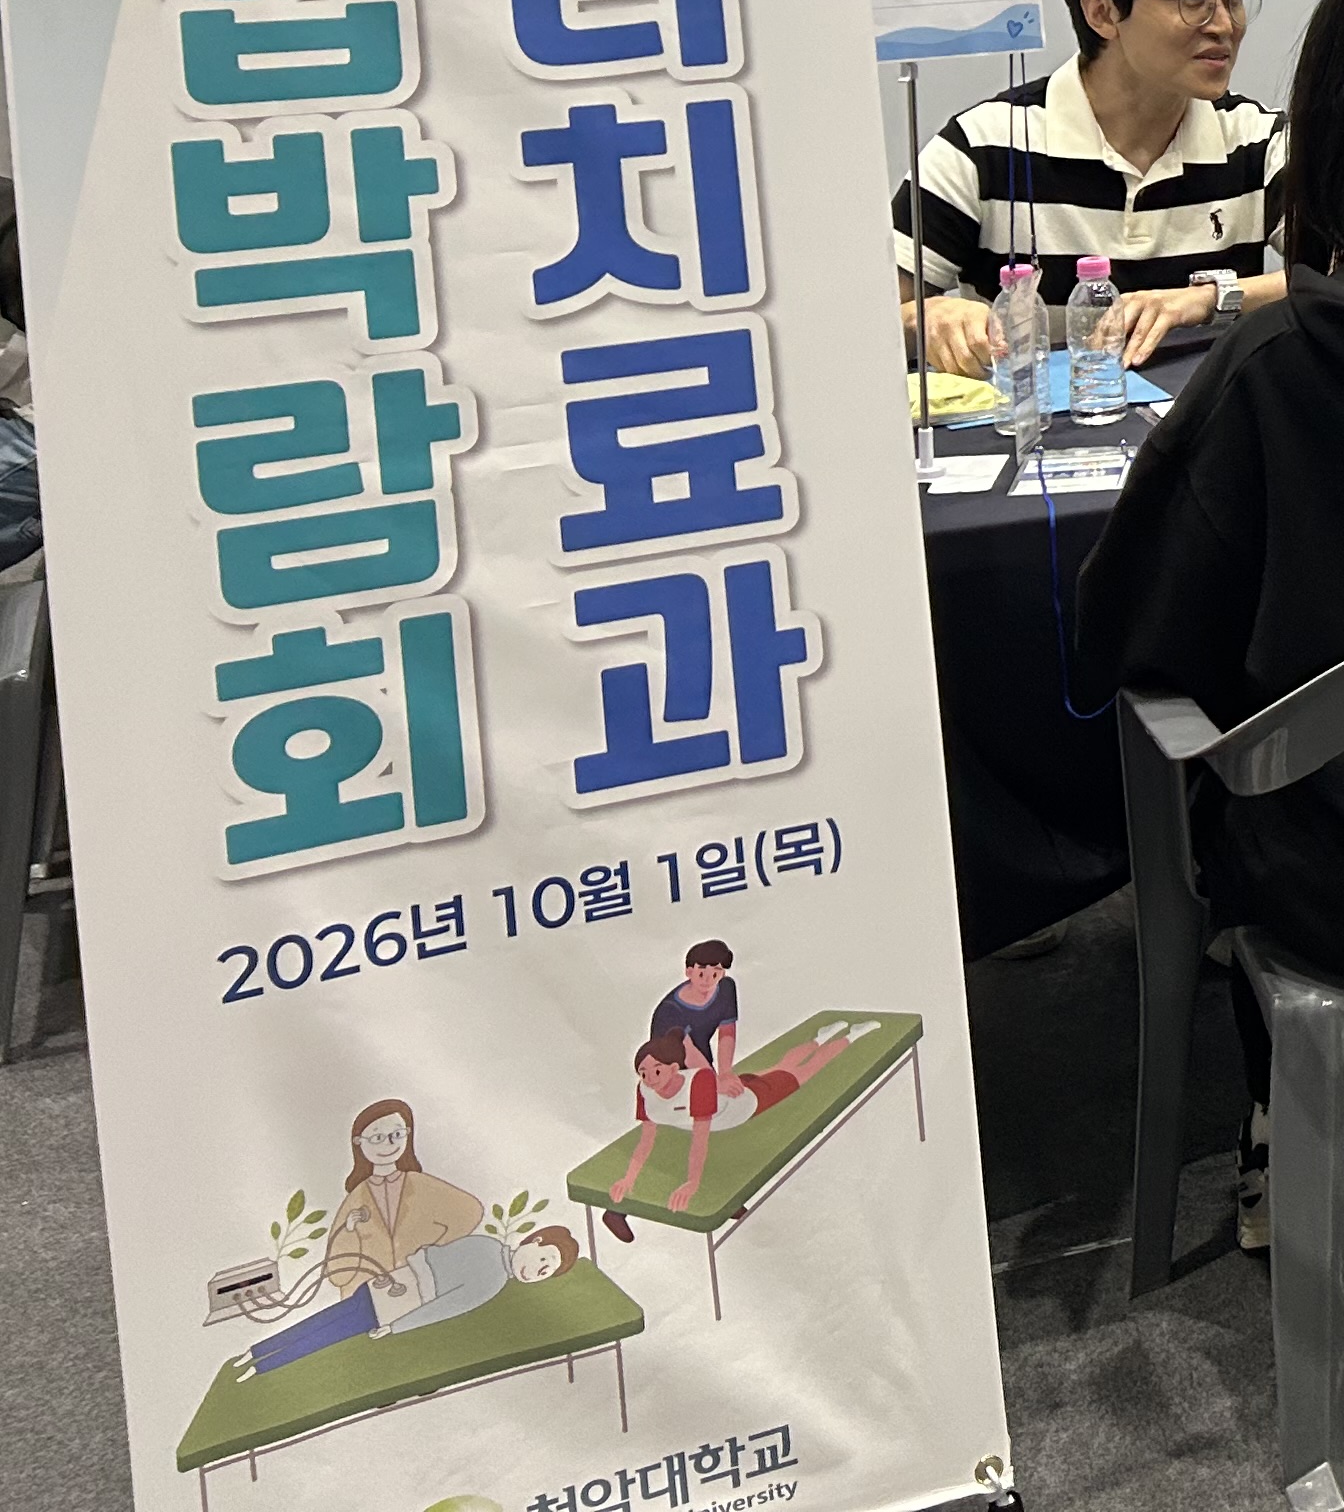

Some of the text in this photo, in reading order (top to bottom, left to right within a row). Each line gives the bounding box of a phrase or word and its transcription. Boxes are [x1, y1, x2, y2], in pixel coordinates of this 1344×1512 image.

[216, 817, 843, 1005] 2026년 10월 1일(목)
